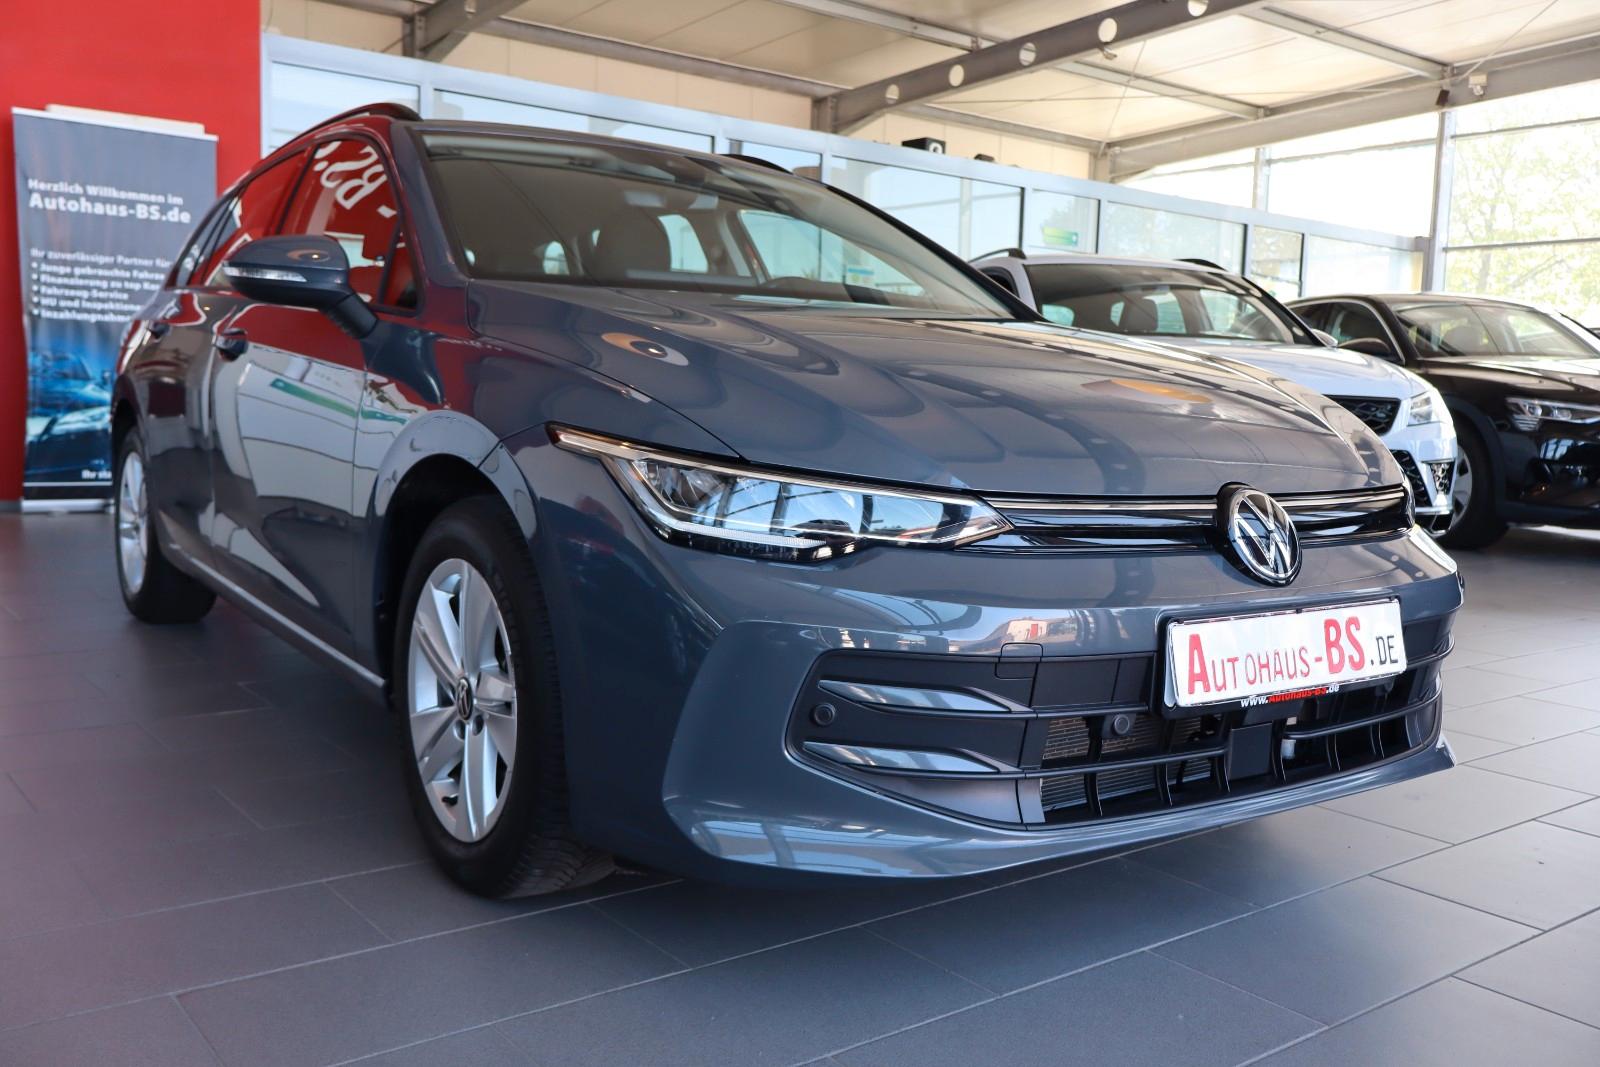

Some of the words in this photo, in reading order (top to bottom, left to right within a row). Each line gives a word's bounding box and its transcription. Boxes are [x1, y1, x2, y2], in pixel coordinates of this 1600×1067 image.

[28, 178, 83, 195] Herzlich
[86, 184, 165, 203] Willkommen
[167, 193, 184, 206] im
[29, 192, 191, 224] Autohaus-BS.de
[116, 254, 153, 267] Partner
[39, 262, 72, 275] Junge
[74, 265, 131, 279] gebrauchte
[39, 274, 108, 289] Finanzierung
